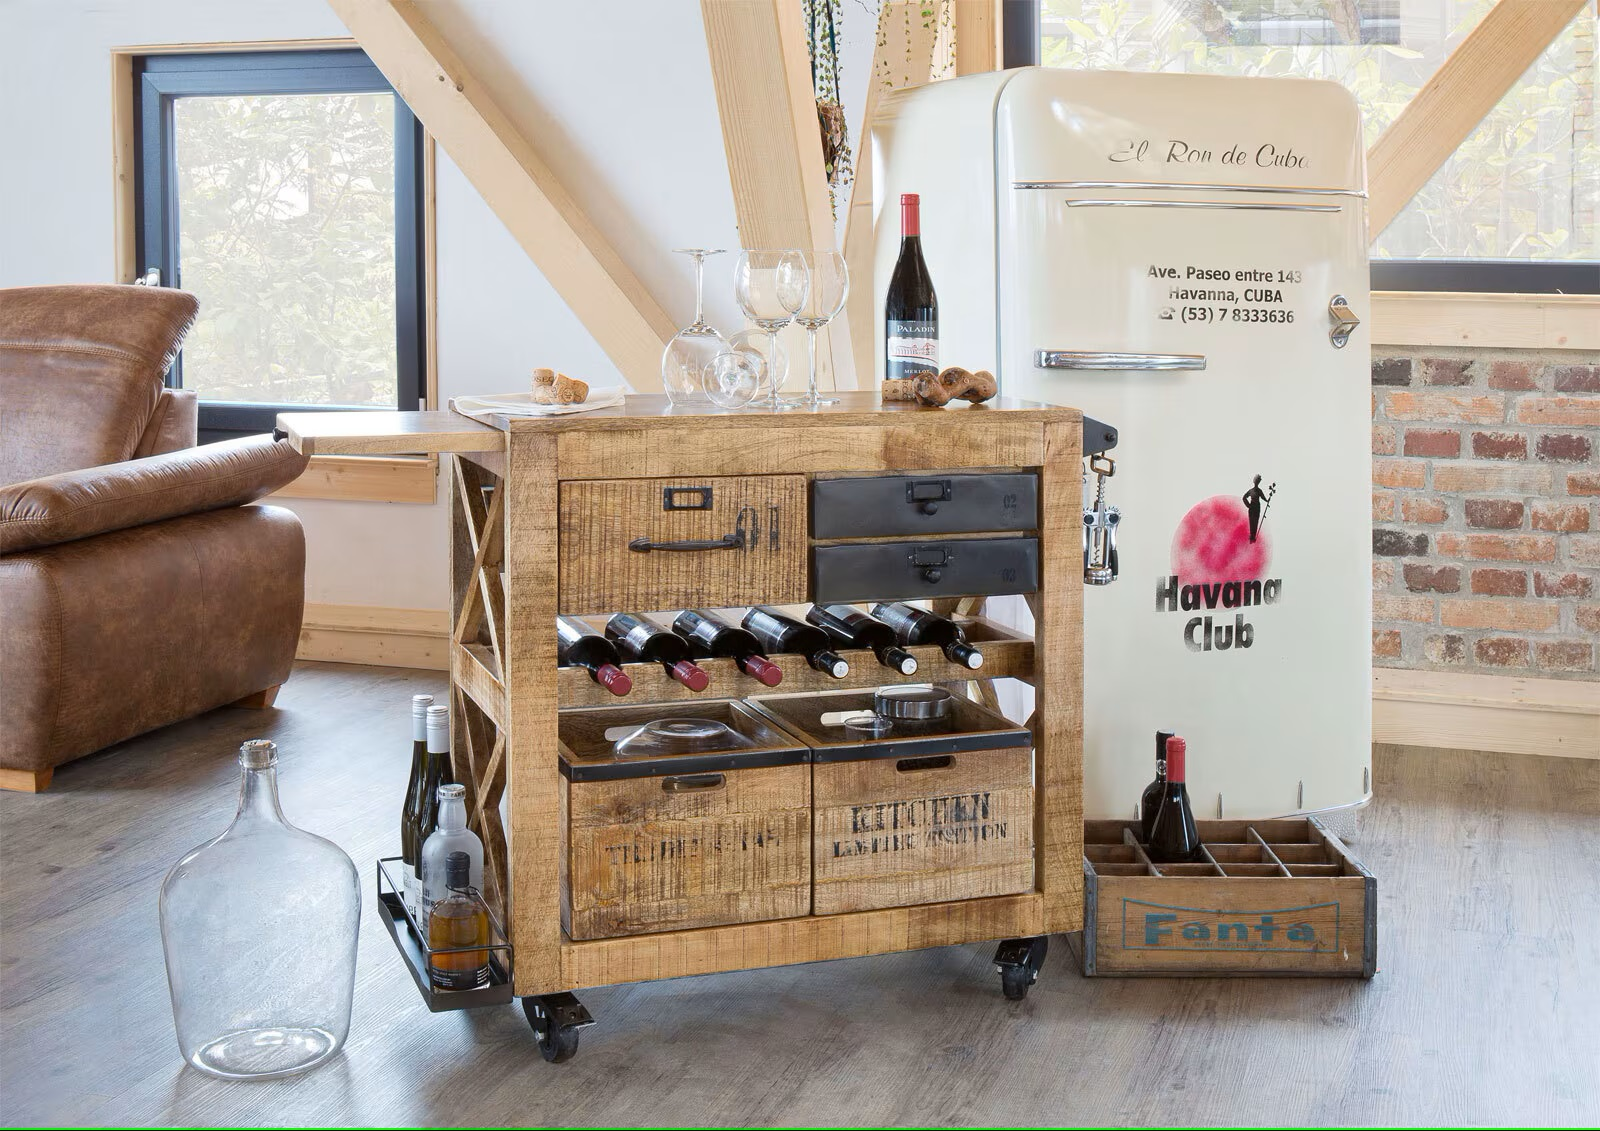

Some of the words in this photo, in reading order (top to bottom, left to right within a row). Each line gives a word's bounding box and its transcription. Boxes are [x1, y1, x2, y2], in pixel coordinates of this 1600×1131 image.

[1108, 139, 1149, 163] El
[1166, 139, 1212, 163] Ron
[1221, 143, 1247, 165] de
[1255, 143, 1311, 169] Cuba
[1148, 264, 1181, 280] Ave.
[1186, 266, 1231, 281] Paseo
[1235, 268, 1273, 283] entre
[1277, 269, 1302, 284] 143
[1169, 286, 1239, 304] Havanna,
[1244, 288, 1283, 303] CUBA
[1181, 306, 1214, 324] (53)
[1218, 308, 1228, 322] 7
[1232, 308, 1295, 324] 8333636
[897, 325, 936, 333] PALADIN
[1156, 575, 1282, 612] Havana
[1183, 613, 1255, 652] Club
[1144, 912, 1315, 945] Fanta
